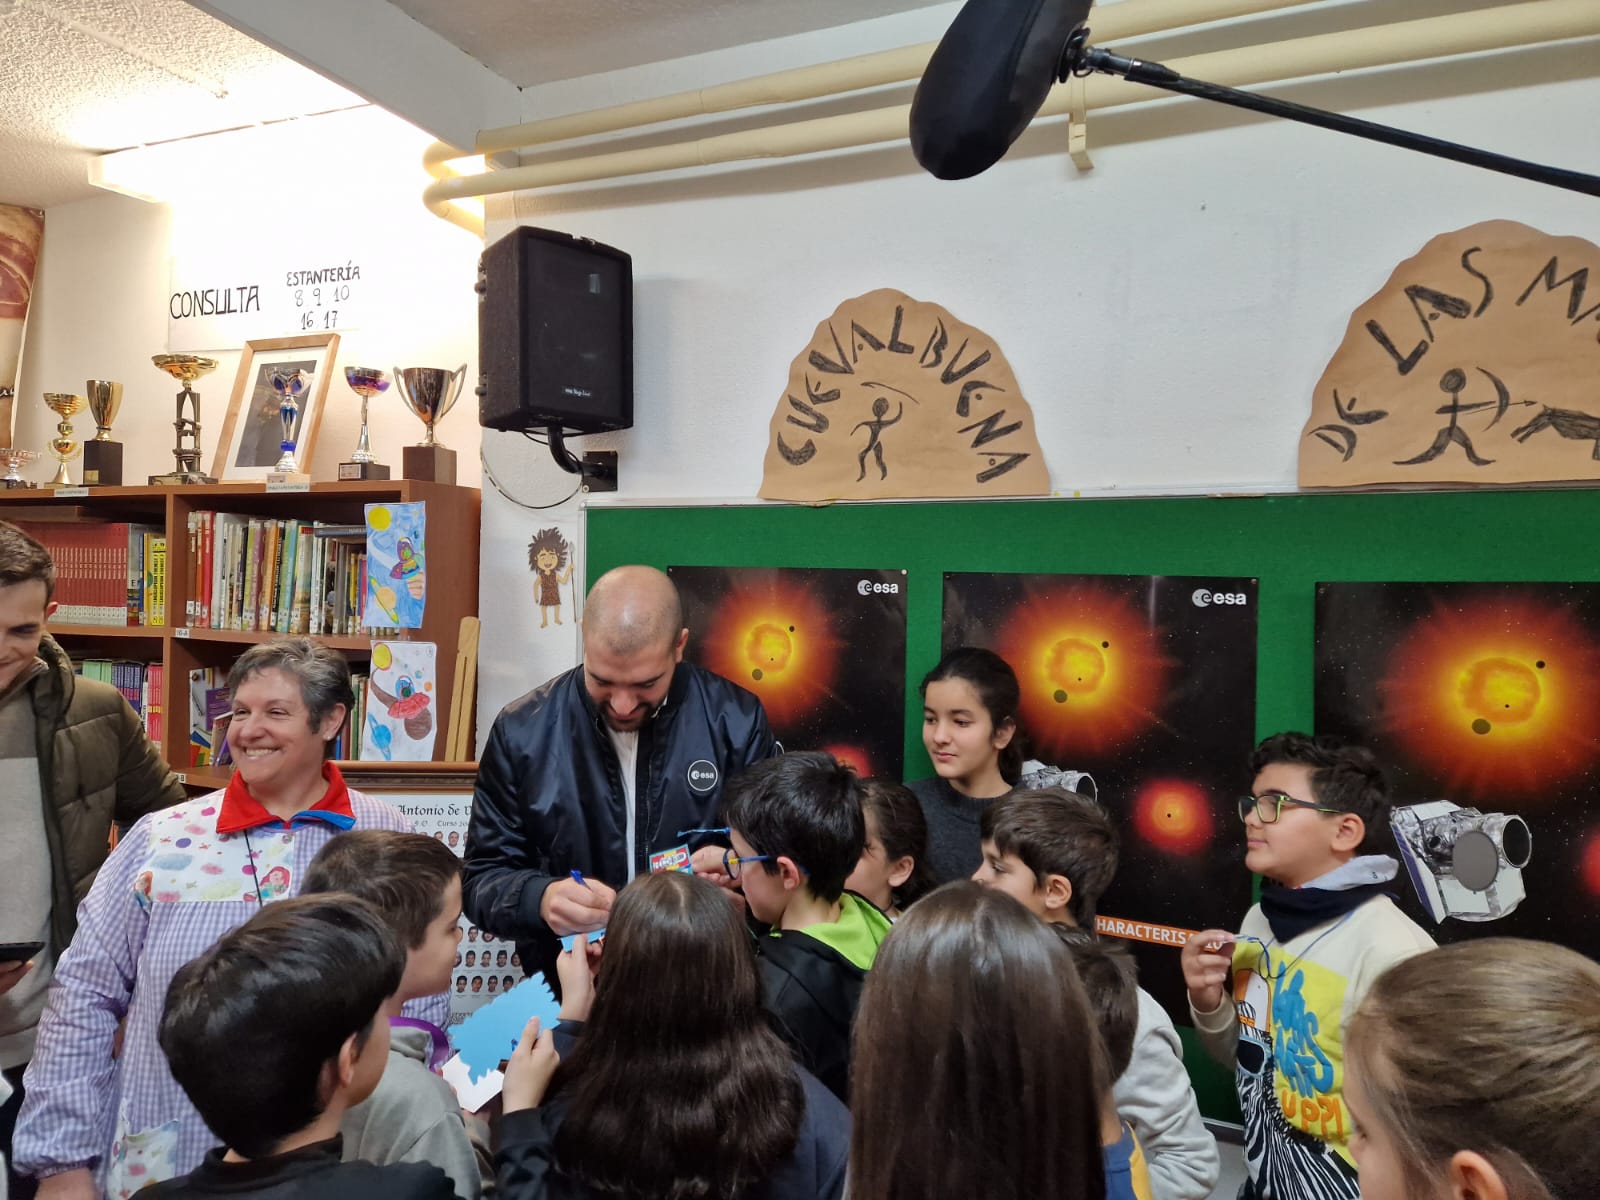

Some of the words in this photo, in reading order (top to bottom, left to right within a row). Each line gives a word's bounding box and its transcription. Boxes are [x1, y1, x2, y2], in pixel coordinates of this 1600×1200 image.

[286, 260, 361, 287] ESTANTERÍA
[170, 285, 260, 320] CONSULTA
[332, 285, 350, 303] 10
[301, 311, 314, 330] 16
[323, 310, 338, 329] 17
[1365, 246, 1494, 376] LAS
[397, 804, 444, 816] Antonio
